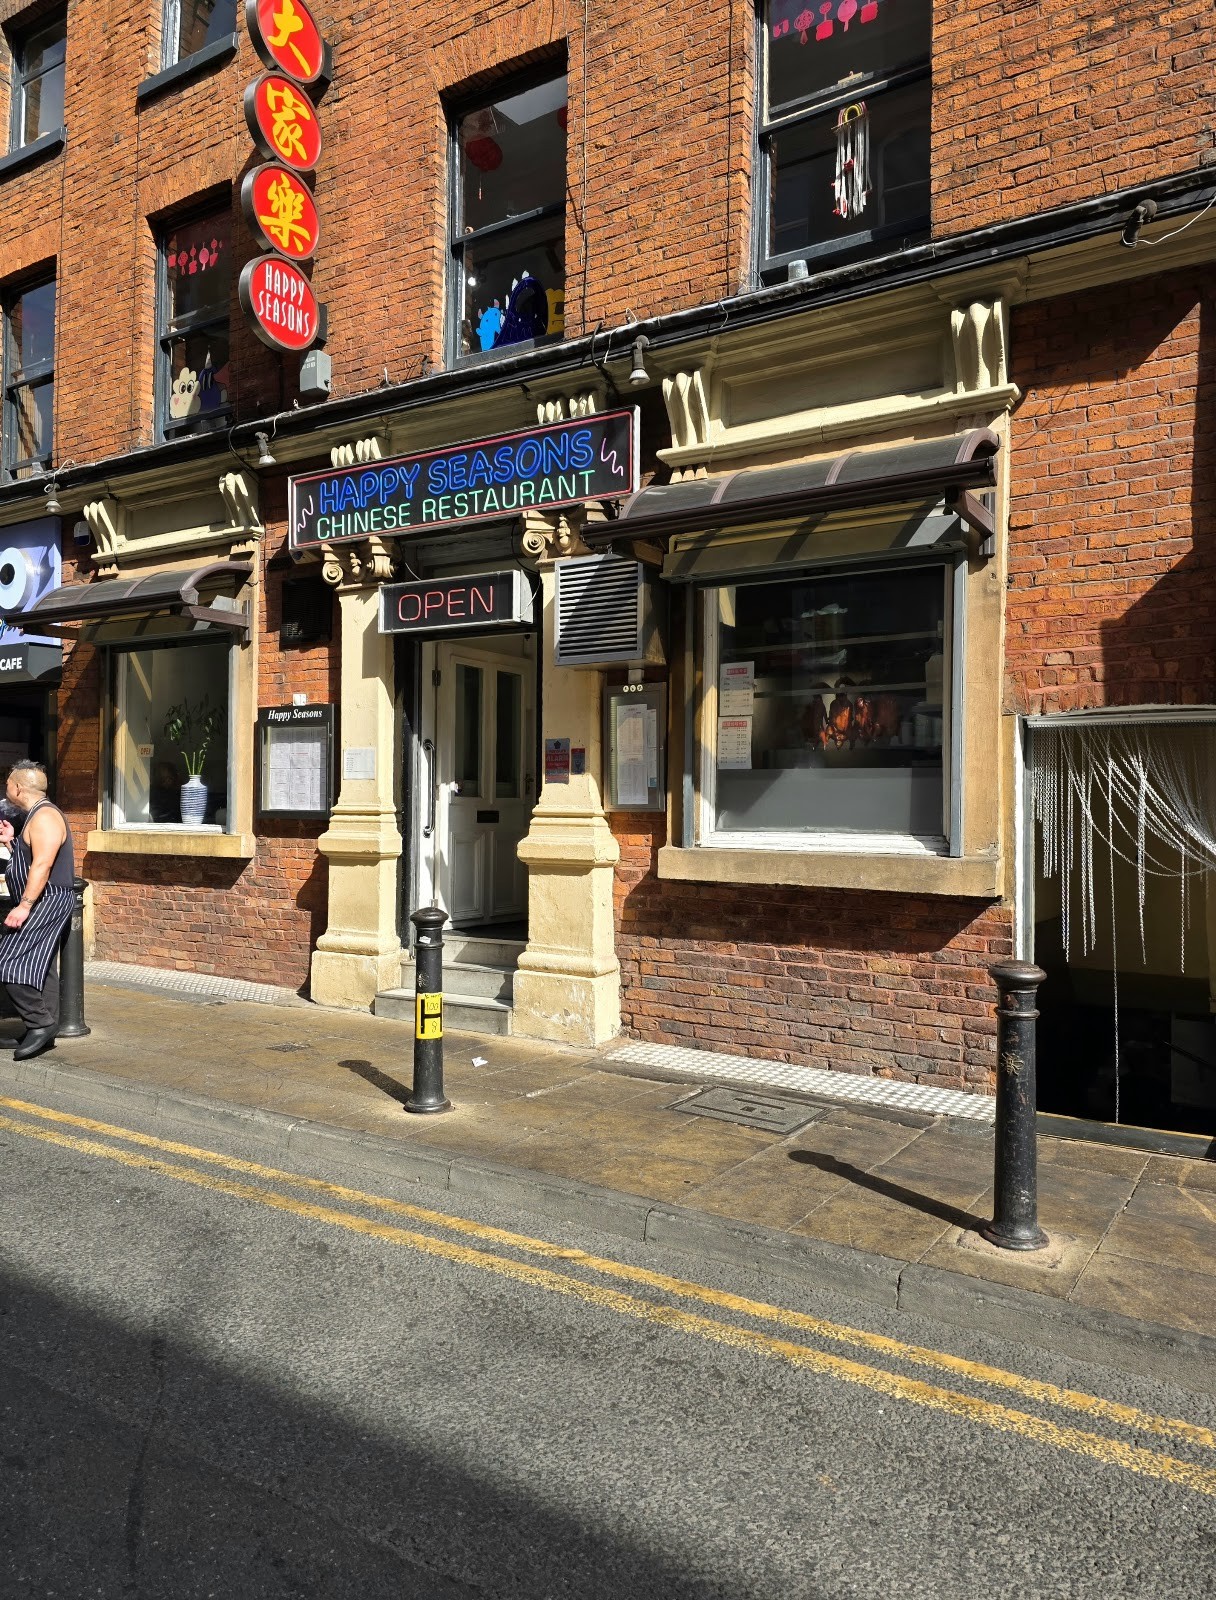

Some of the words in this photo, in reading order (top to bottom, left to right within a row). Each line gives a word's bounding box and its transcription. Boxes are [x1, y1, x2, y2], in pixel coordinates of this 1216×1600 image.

[265, 263, 305, 306] HAPPY
[258, 290, 310, 337] SEASONS
[319, 463, 420, 514] HAPPY
[428, 430, 594, 495] SEASONS
[317, 503, 411, 540] CHINESE
[422, 470, 596, 522] RESTAURANT
[398, 586, 494, 621] OPEN
[0, 656, 23, 671] CAFE
[267, 709, 292, 721] Happy
[292, 708, 323, 719] Seasons
